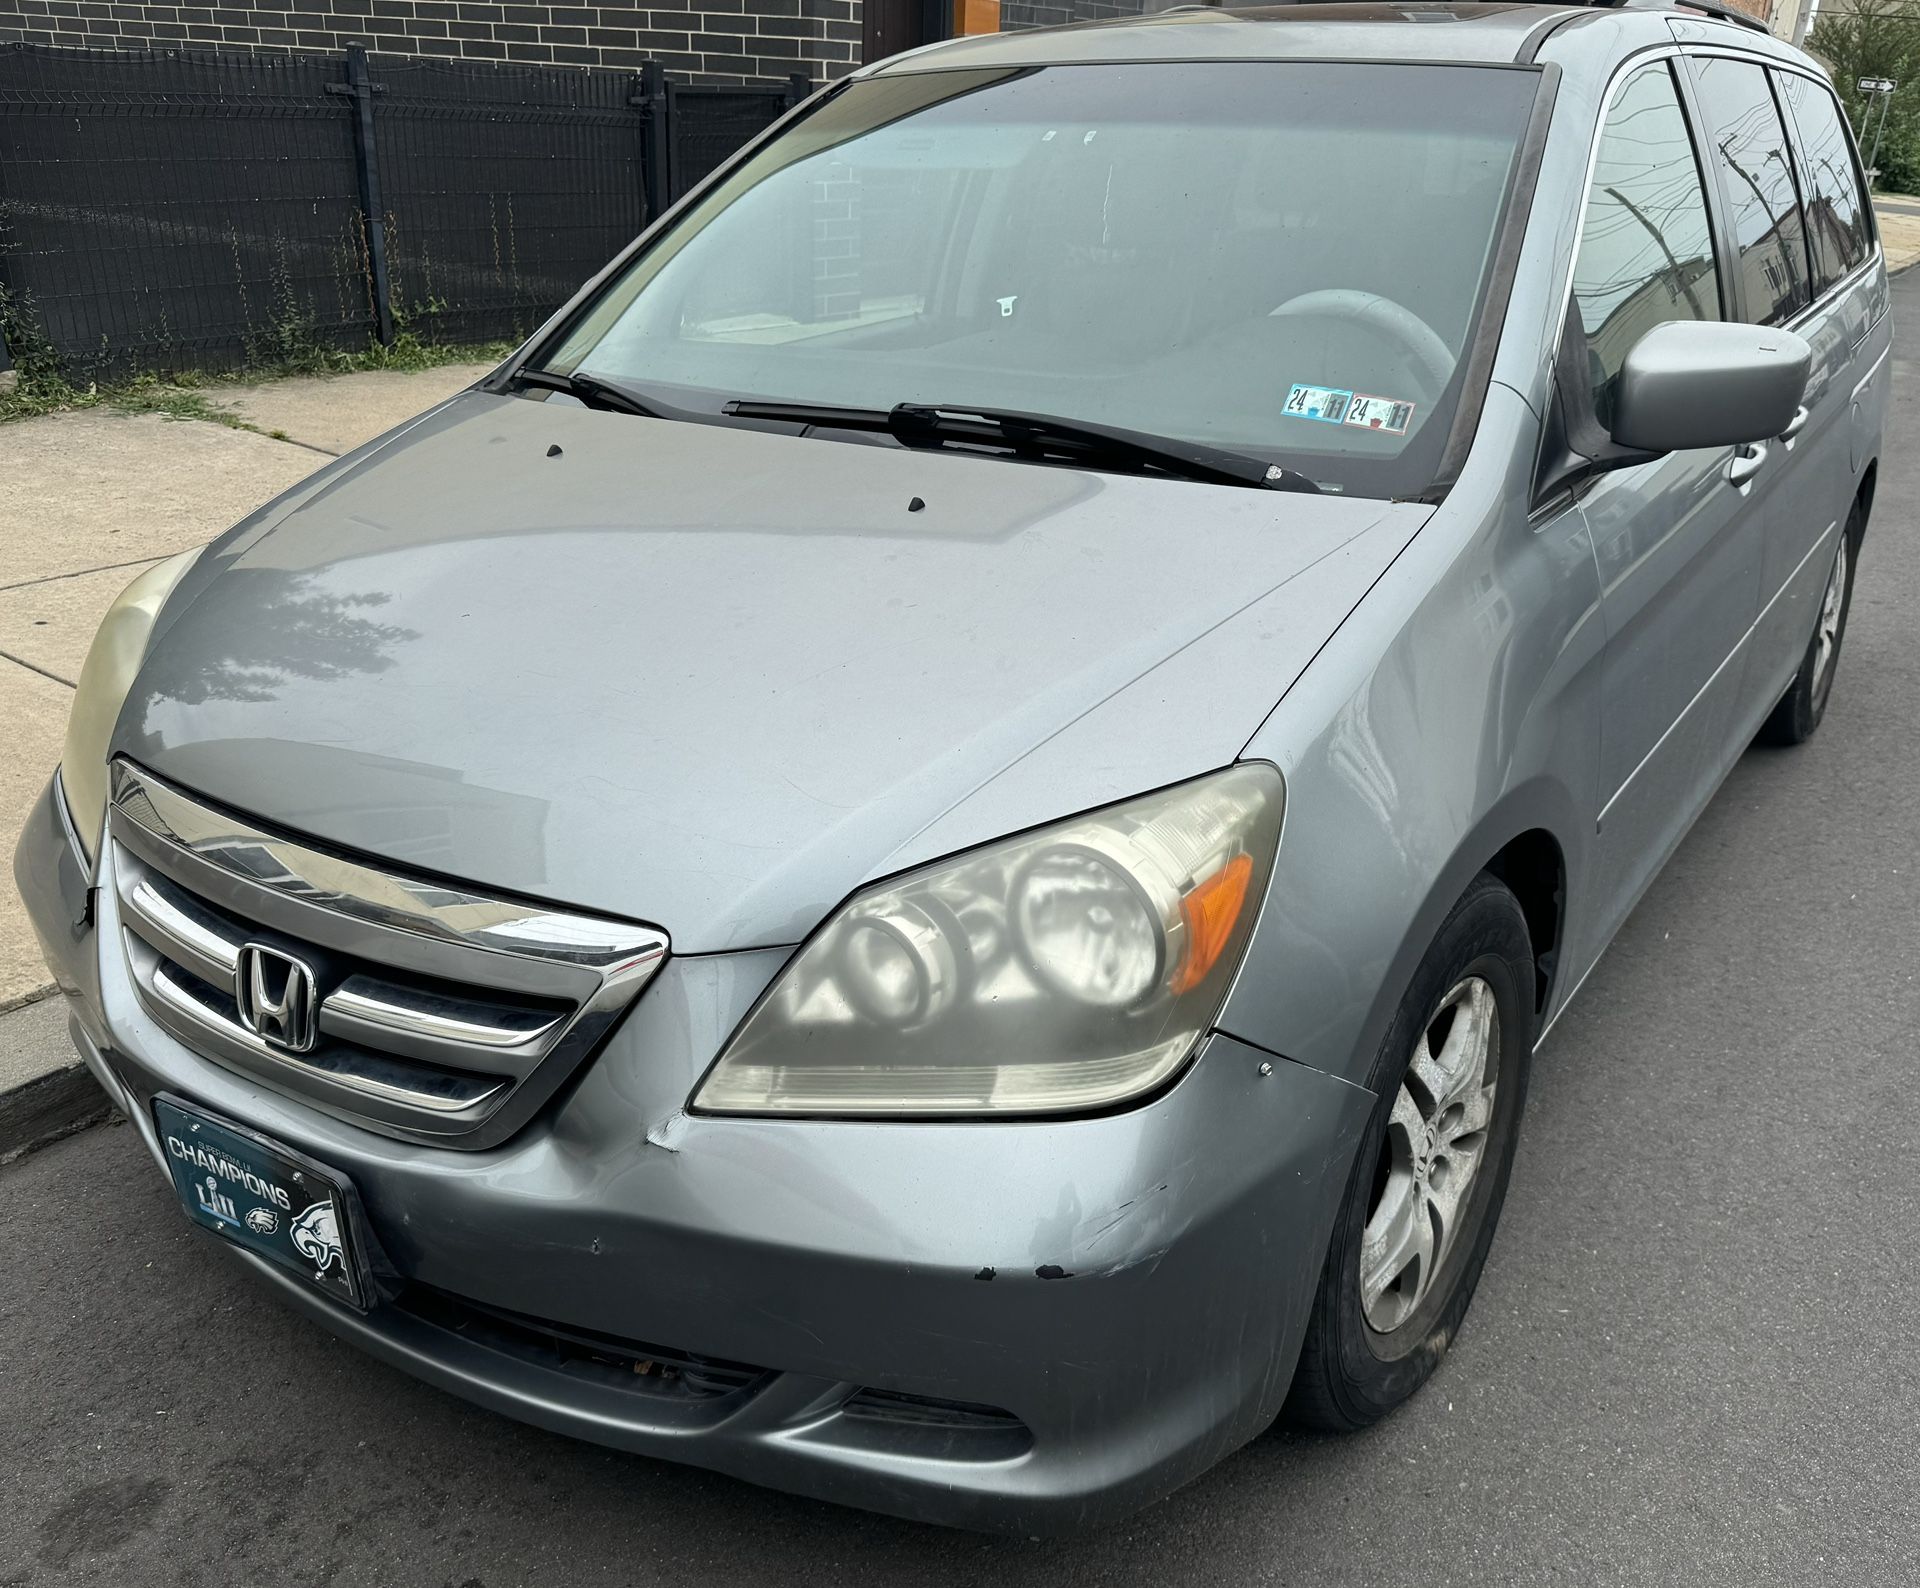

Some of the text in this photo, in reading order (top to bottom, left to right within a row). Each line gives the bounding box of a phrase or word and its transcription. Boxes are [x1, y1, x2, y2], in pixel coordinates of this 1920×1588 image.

[1287, 388, 1345, 419] 24 11
[1349, 398, 1411, 428] 24 11
[197, 1140, 221, 1158] SUPER
[167, 1135, 292, 1211] CHAMPIONS
